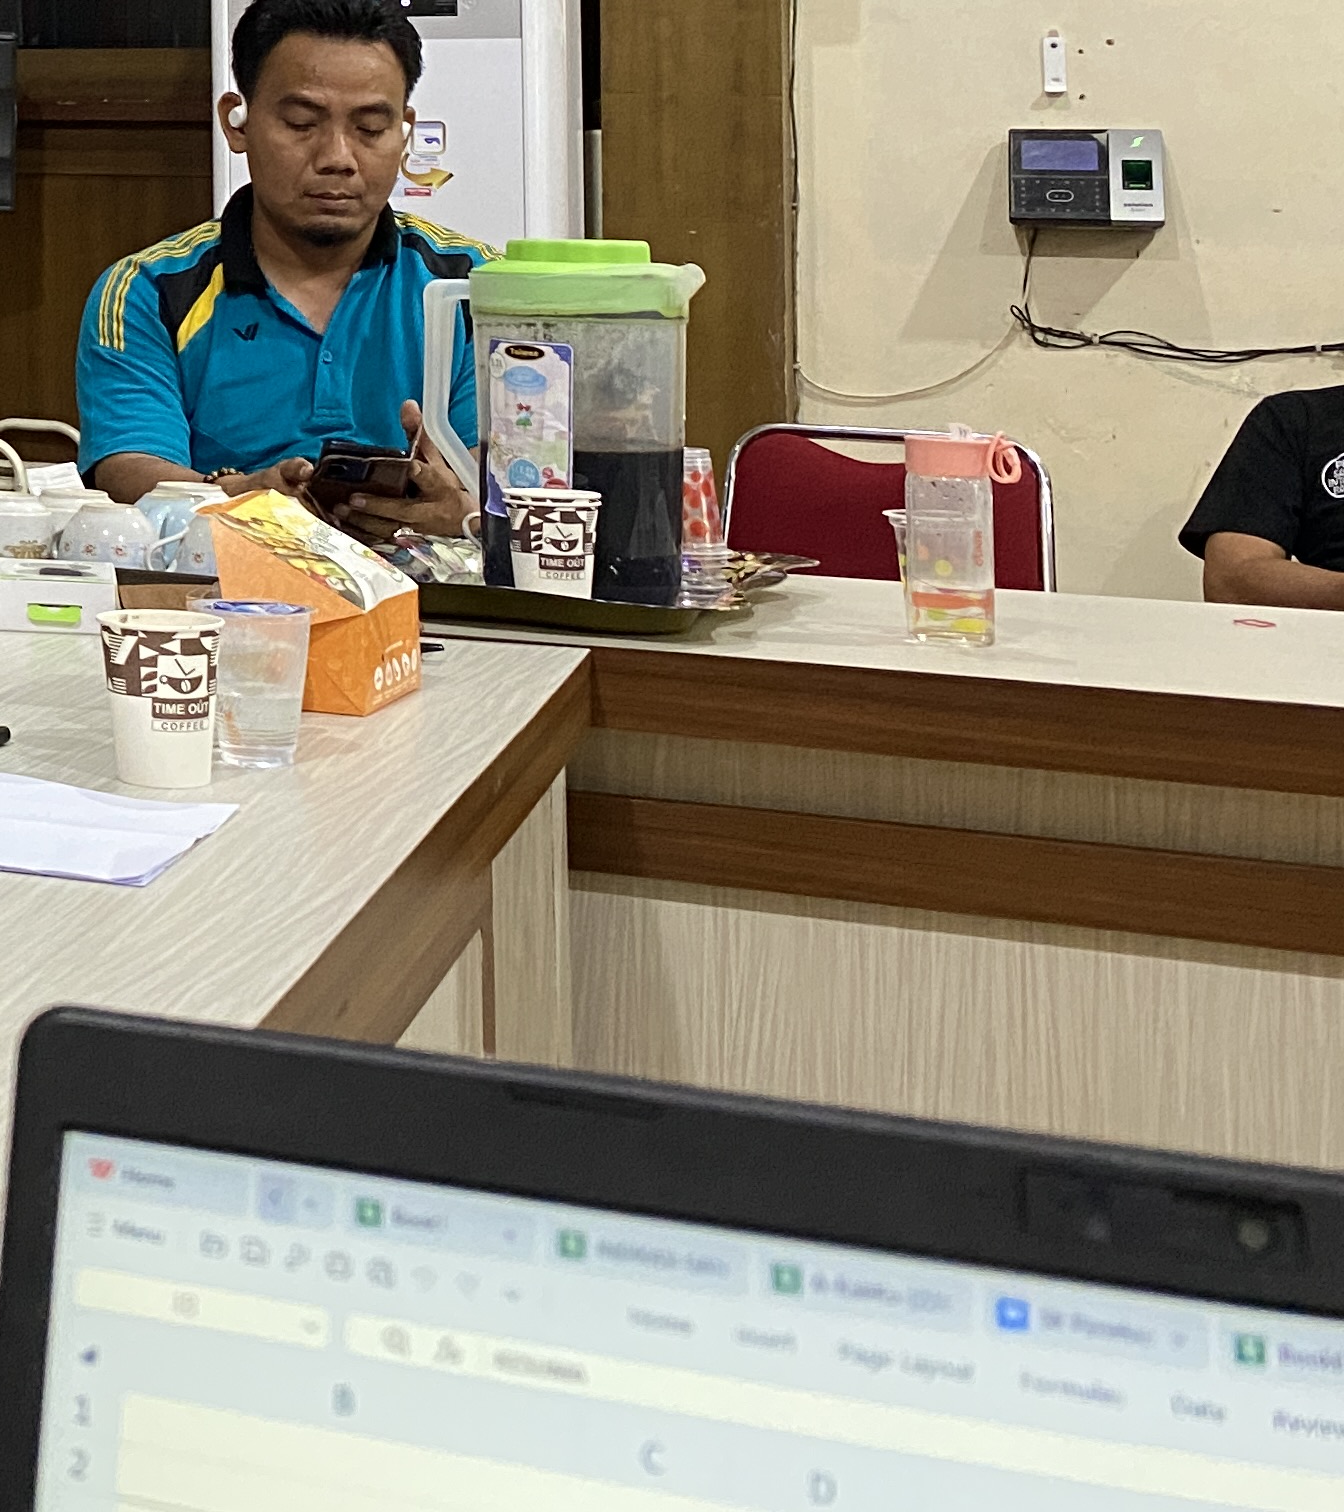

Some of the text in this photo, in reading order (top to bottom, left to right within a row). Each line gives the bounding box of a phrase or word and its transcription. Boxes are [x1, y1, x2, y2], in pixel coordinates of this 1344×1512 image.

[540, 557, 564, 567] TIME
[153, 699, 209, 715] TIME OUT
[161, 720, 204, 730] COFFEE
